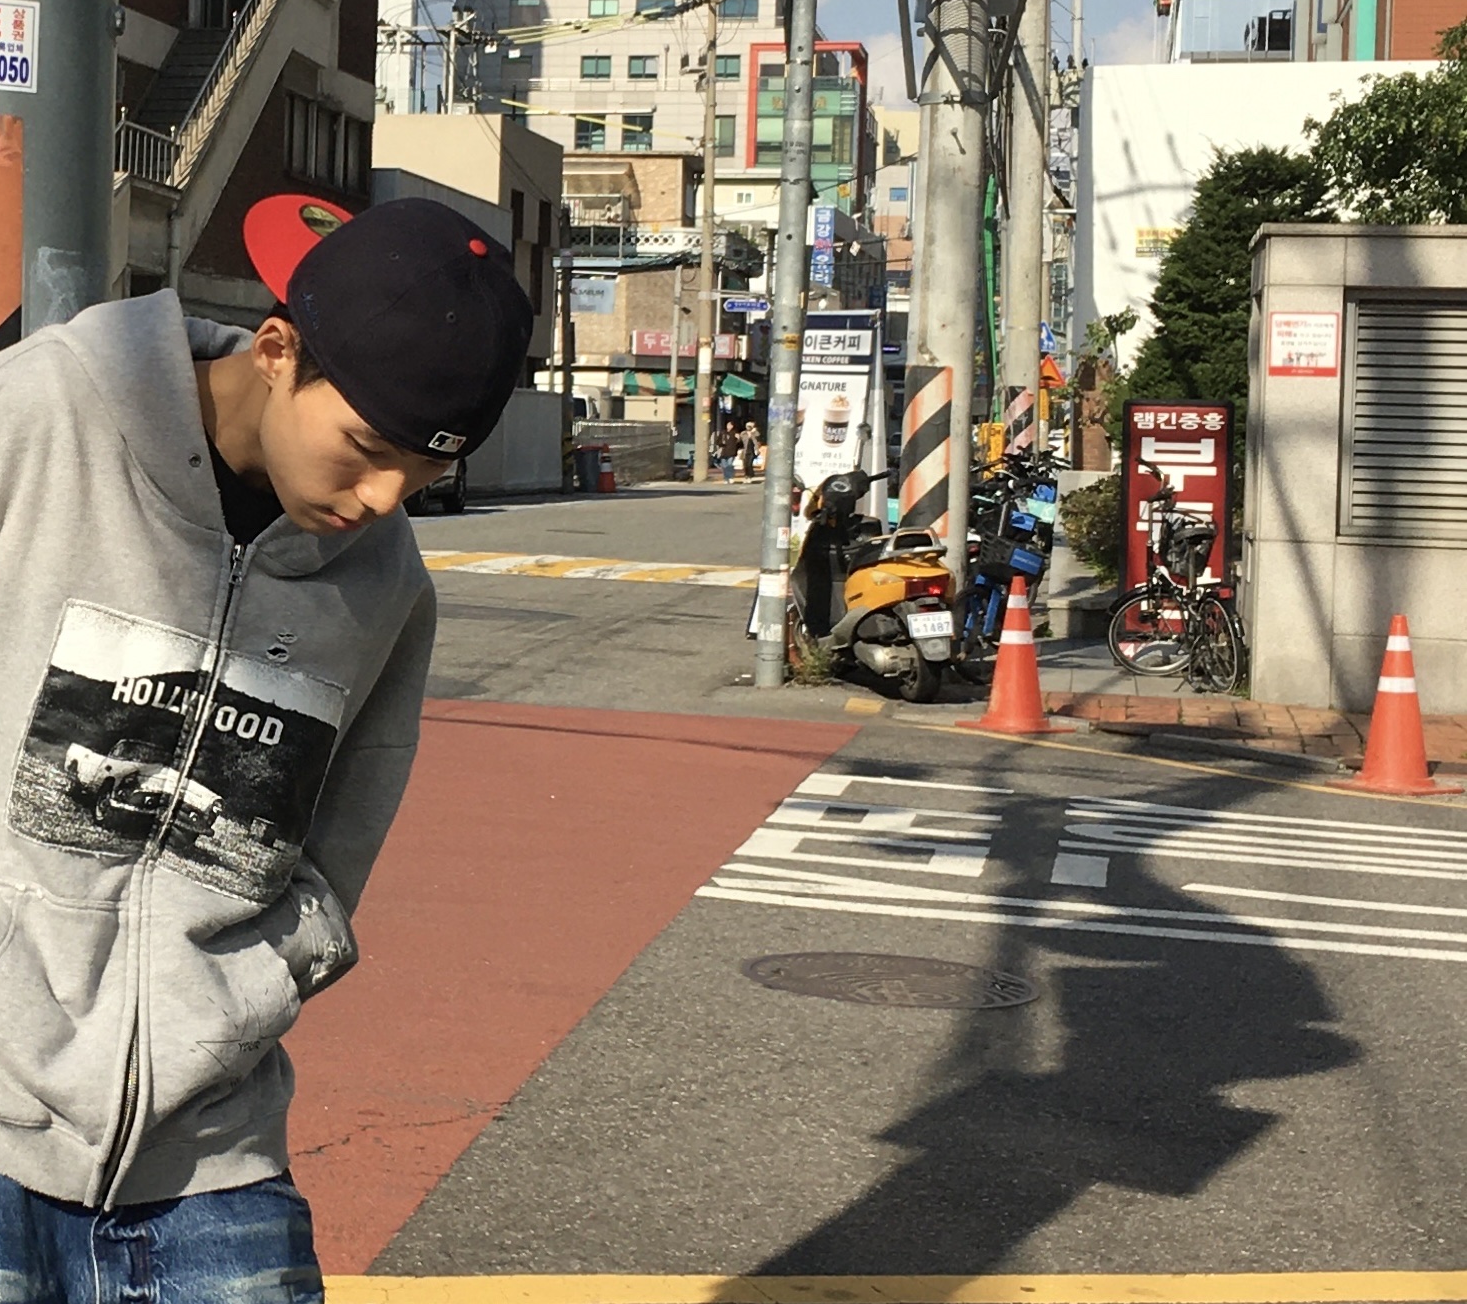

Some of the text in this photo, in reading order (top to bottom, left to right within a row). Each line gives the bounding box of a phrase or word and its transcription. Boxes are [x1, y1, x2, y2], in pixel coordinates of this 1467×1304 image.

[803, 334, 862, 351] 이큰커피
[802, 355, 821, 364] AKEN
[800, 380, 848, 392] GNATURE
